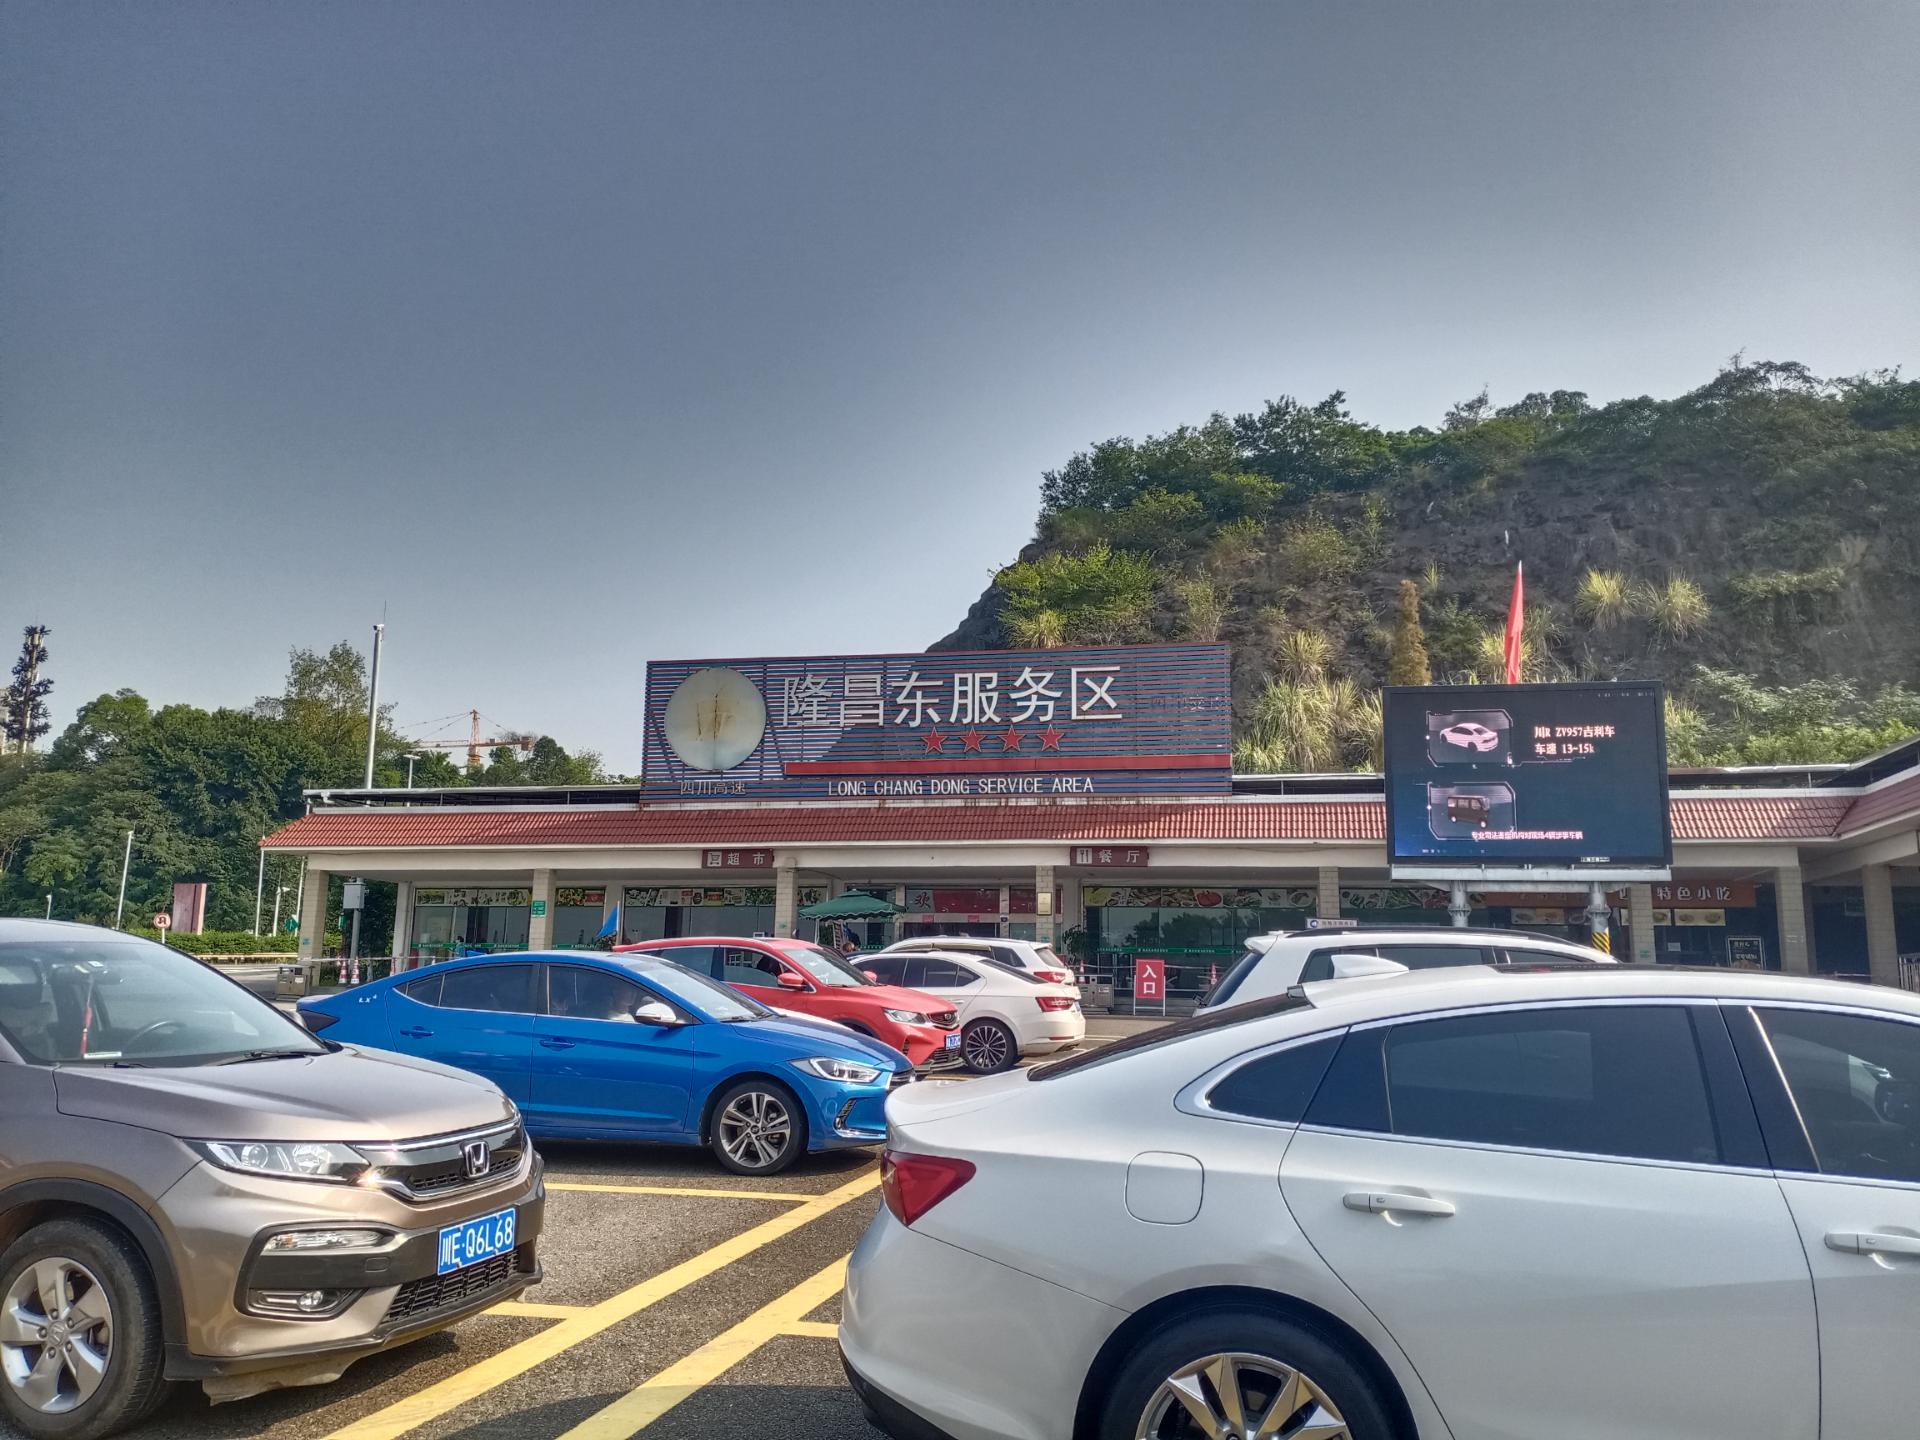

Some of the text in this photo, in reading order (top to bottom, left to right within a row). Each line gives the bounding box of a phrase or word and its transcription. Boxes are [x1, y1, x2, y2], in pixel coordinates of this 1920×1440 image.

[782, 665, 1123, 729] 隆昌东服务区
[1535, 743, 1557, 754] 车速
[680, 780, 746, 796] 四川高速
[828, 777, 1094, 796] LONG CHANG DONG SERVICE AREA
[726, 851, 766, 866] 超市
[1097, 850, 1140, 864] 餐厅
[914, 891, 932, 910] 欢
[1657, 886, 1732, 901] 特色小吃
[1142, 964, 1157, 994] 入口
